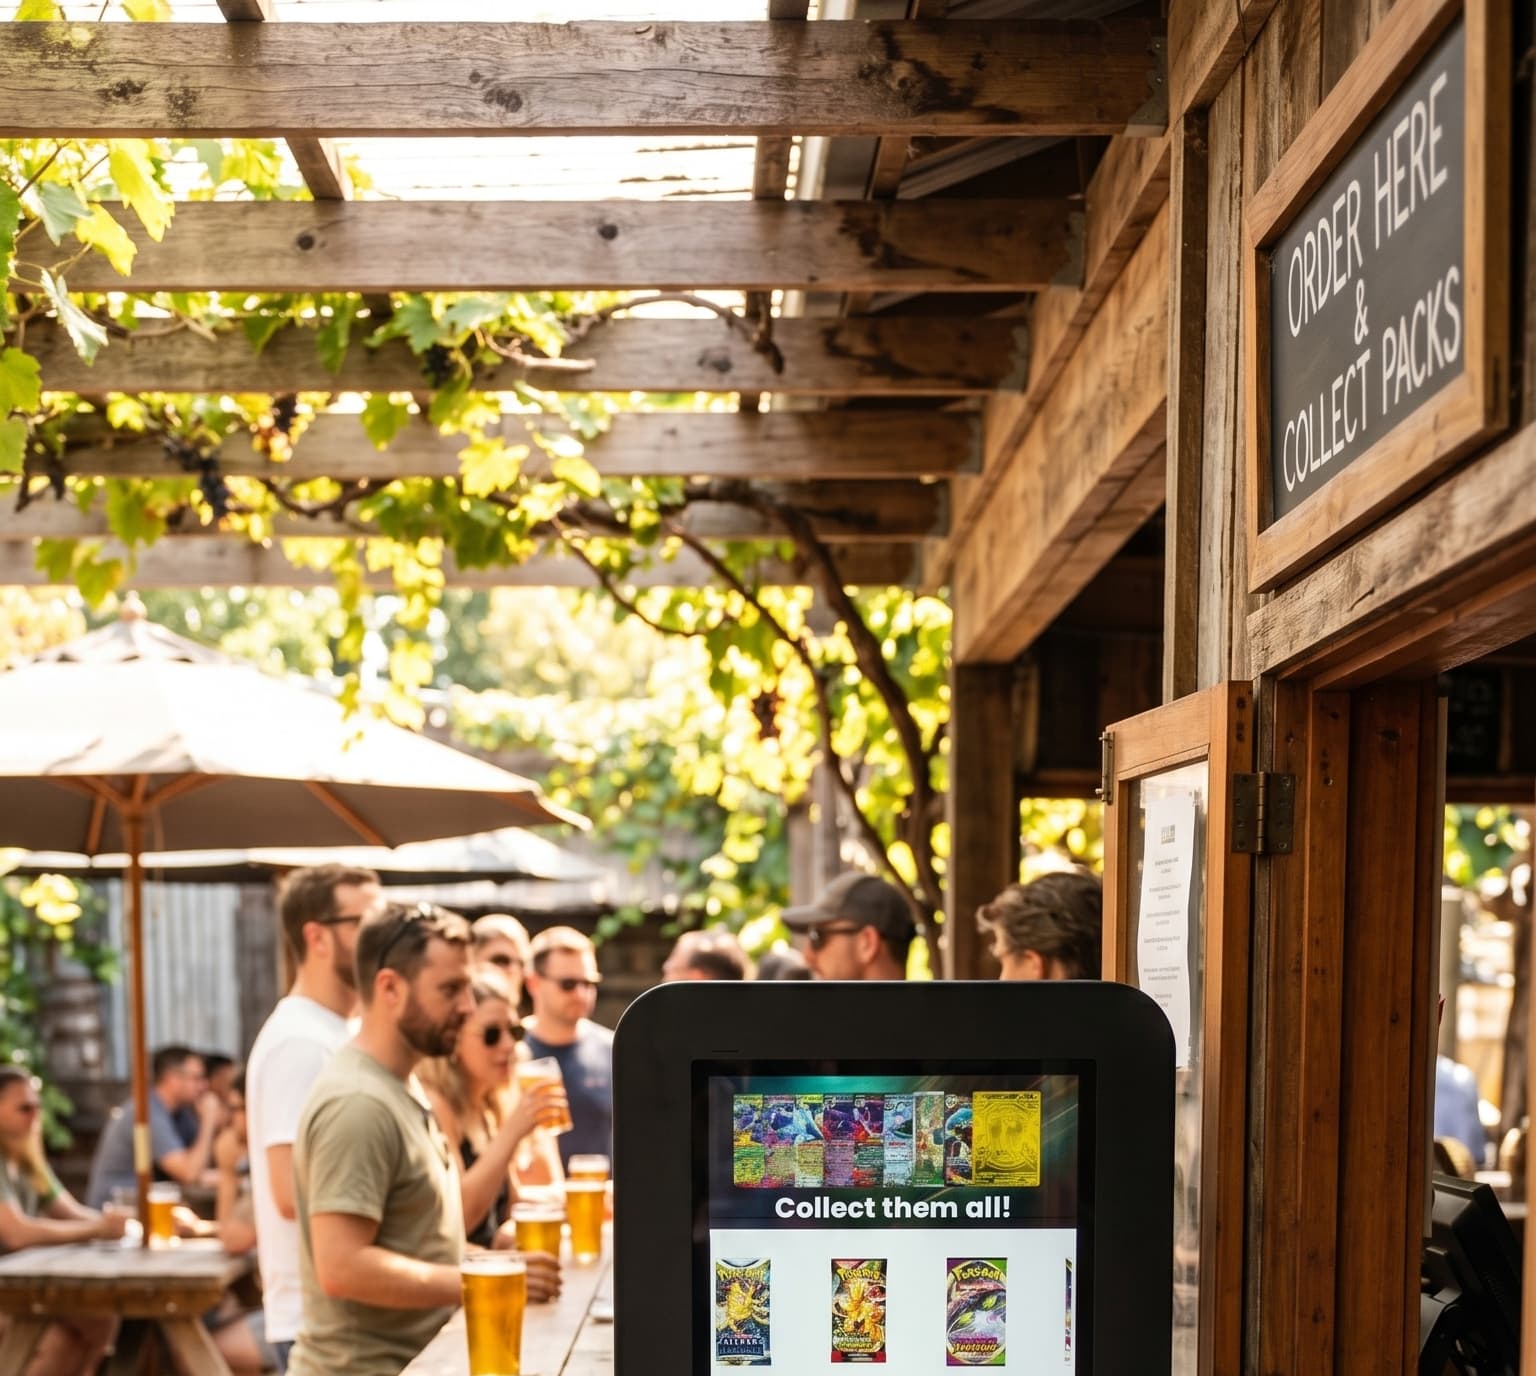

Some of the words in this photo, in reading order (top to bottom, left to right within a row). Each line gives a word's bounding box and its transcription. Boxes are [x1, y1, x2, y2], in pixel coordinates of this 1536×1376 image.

[1288, 179, 1363, 338] ORDER
[1374, 71, 1447, 251] HERE
[1283, 348, 1371, 492] COLLECT
[1382, 265, 1461, 416] PACKS
[1354, 278, 1369, 345] &
[774, 1196, 876, 1219] Collect
[881, 1196, 958, 1219] them
[965, 1195, 1011, 1219] all!
